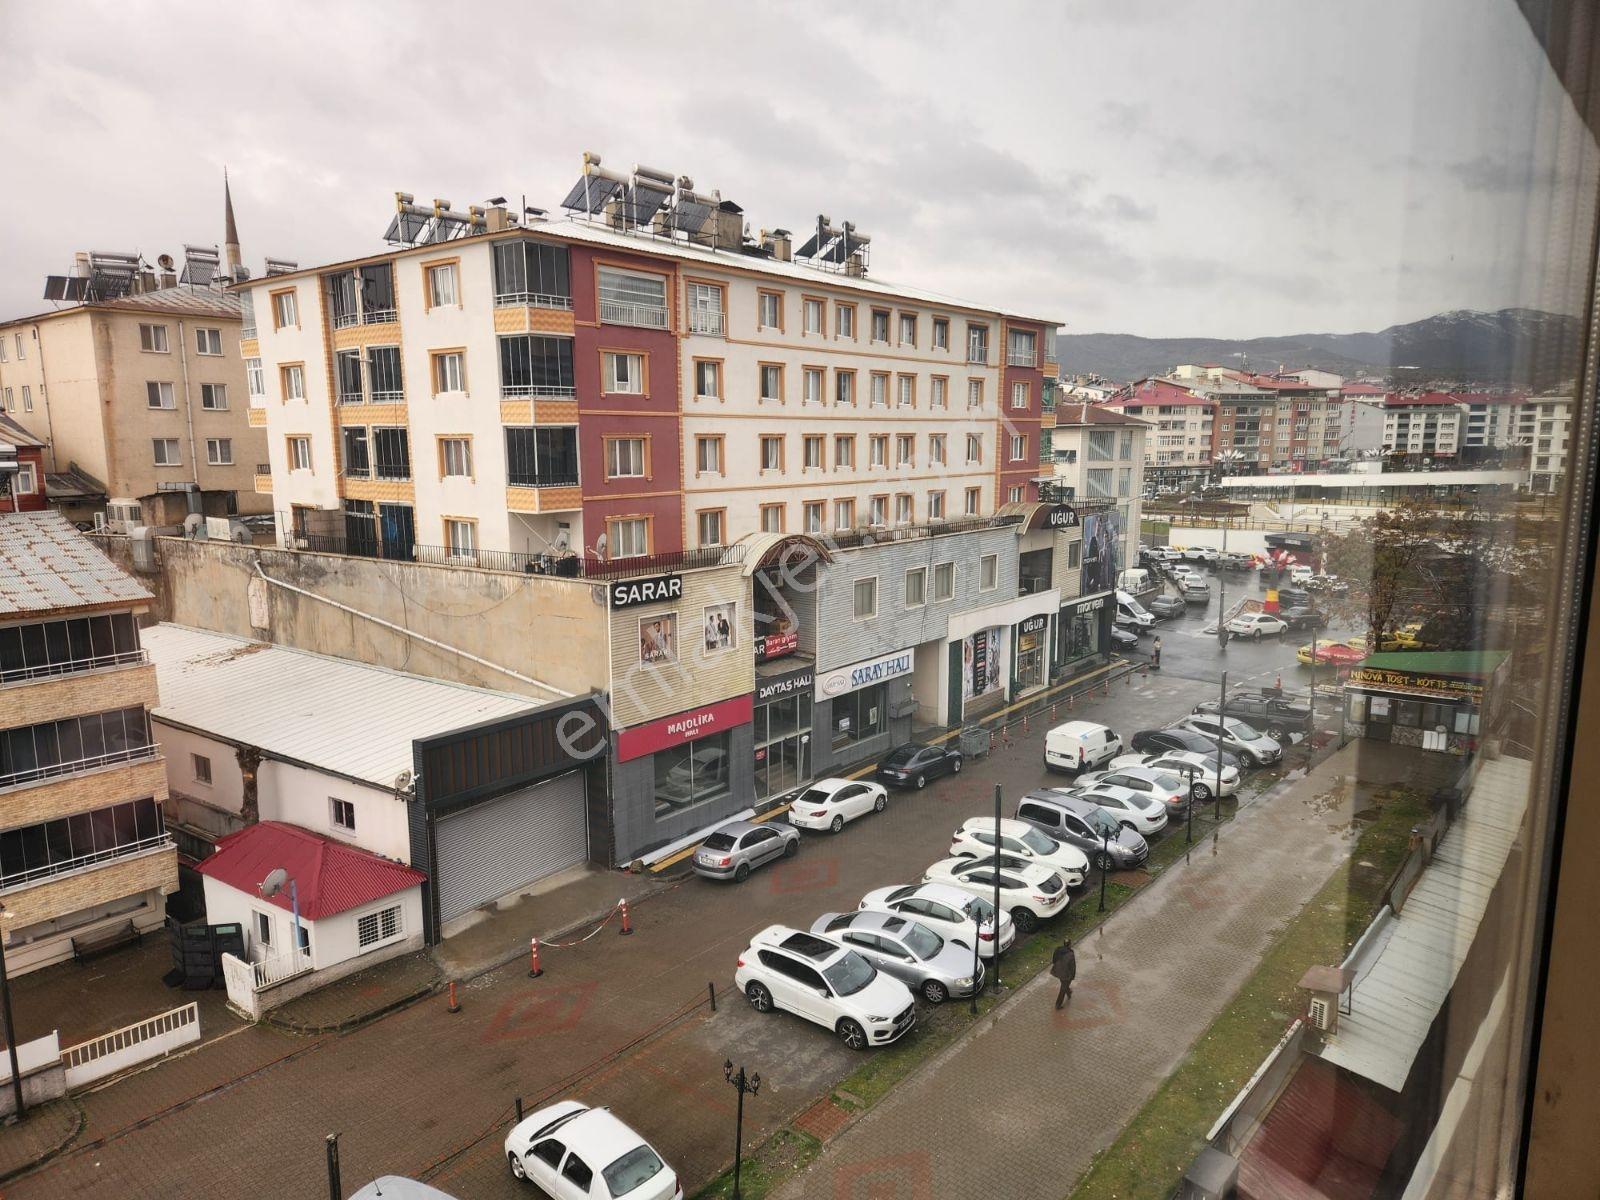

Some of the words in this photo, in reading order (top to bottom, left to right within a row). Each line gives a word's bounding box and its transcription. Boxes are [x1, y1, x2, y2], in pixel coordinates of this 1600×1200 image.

[1051, 510, 1075, 526] UĞUR
[614, 579, 681, 605] SARAR
[1077, 598, 1104, 614] morven
[851, 662, 885, 688] SARAY
[886, 655, 910, 676] HALI
[793, 674, 812, 689] HALI
[667, 713, 714, 735] MAJOLİKA
